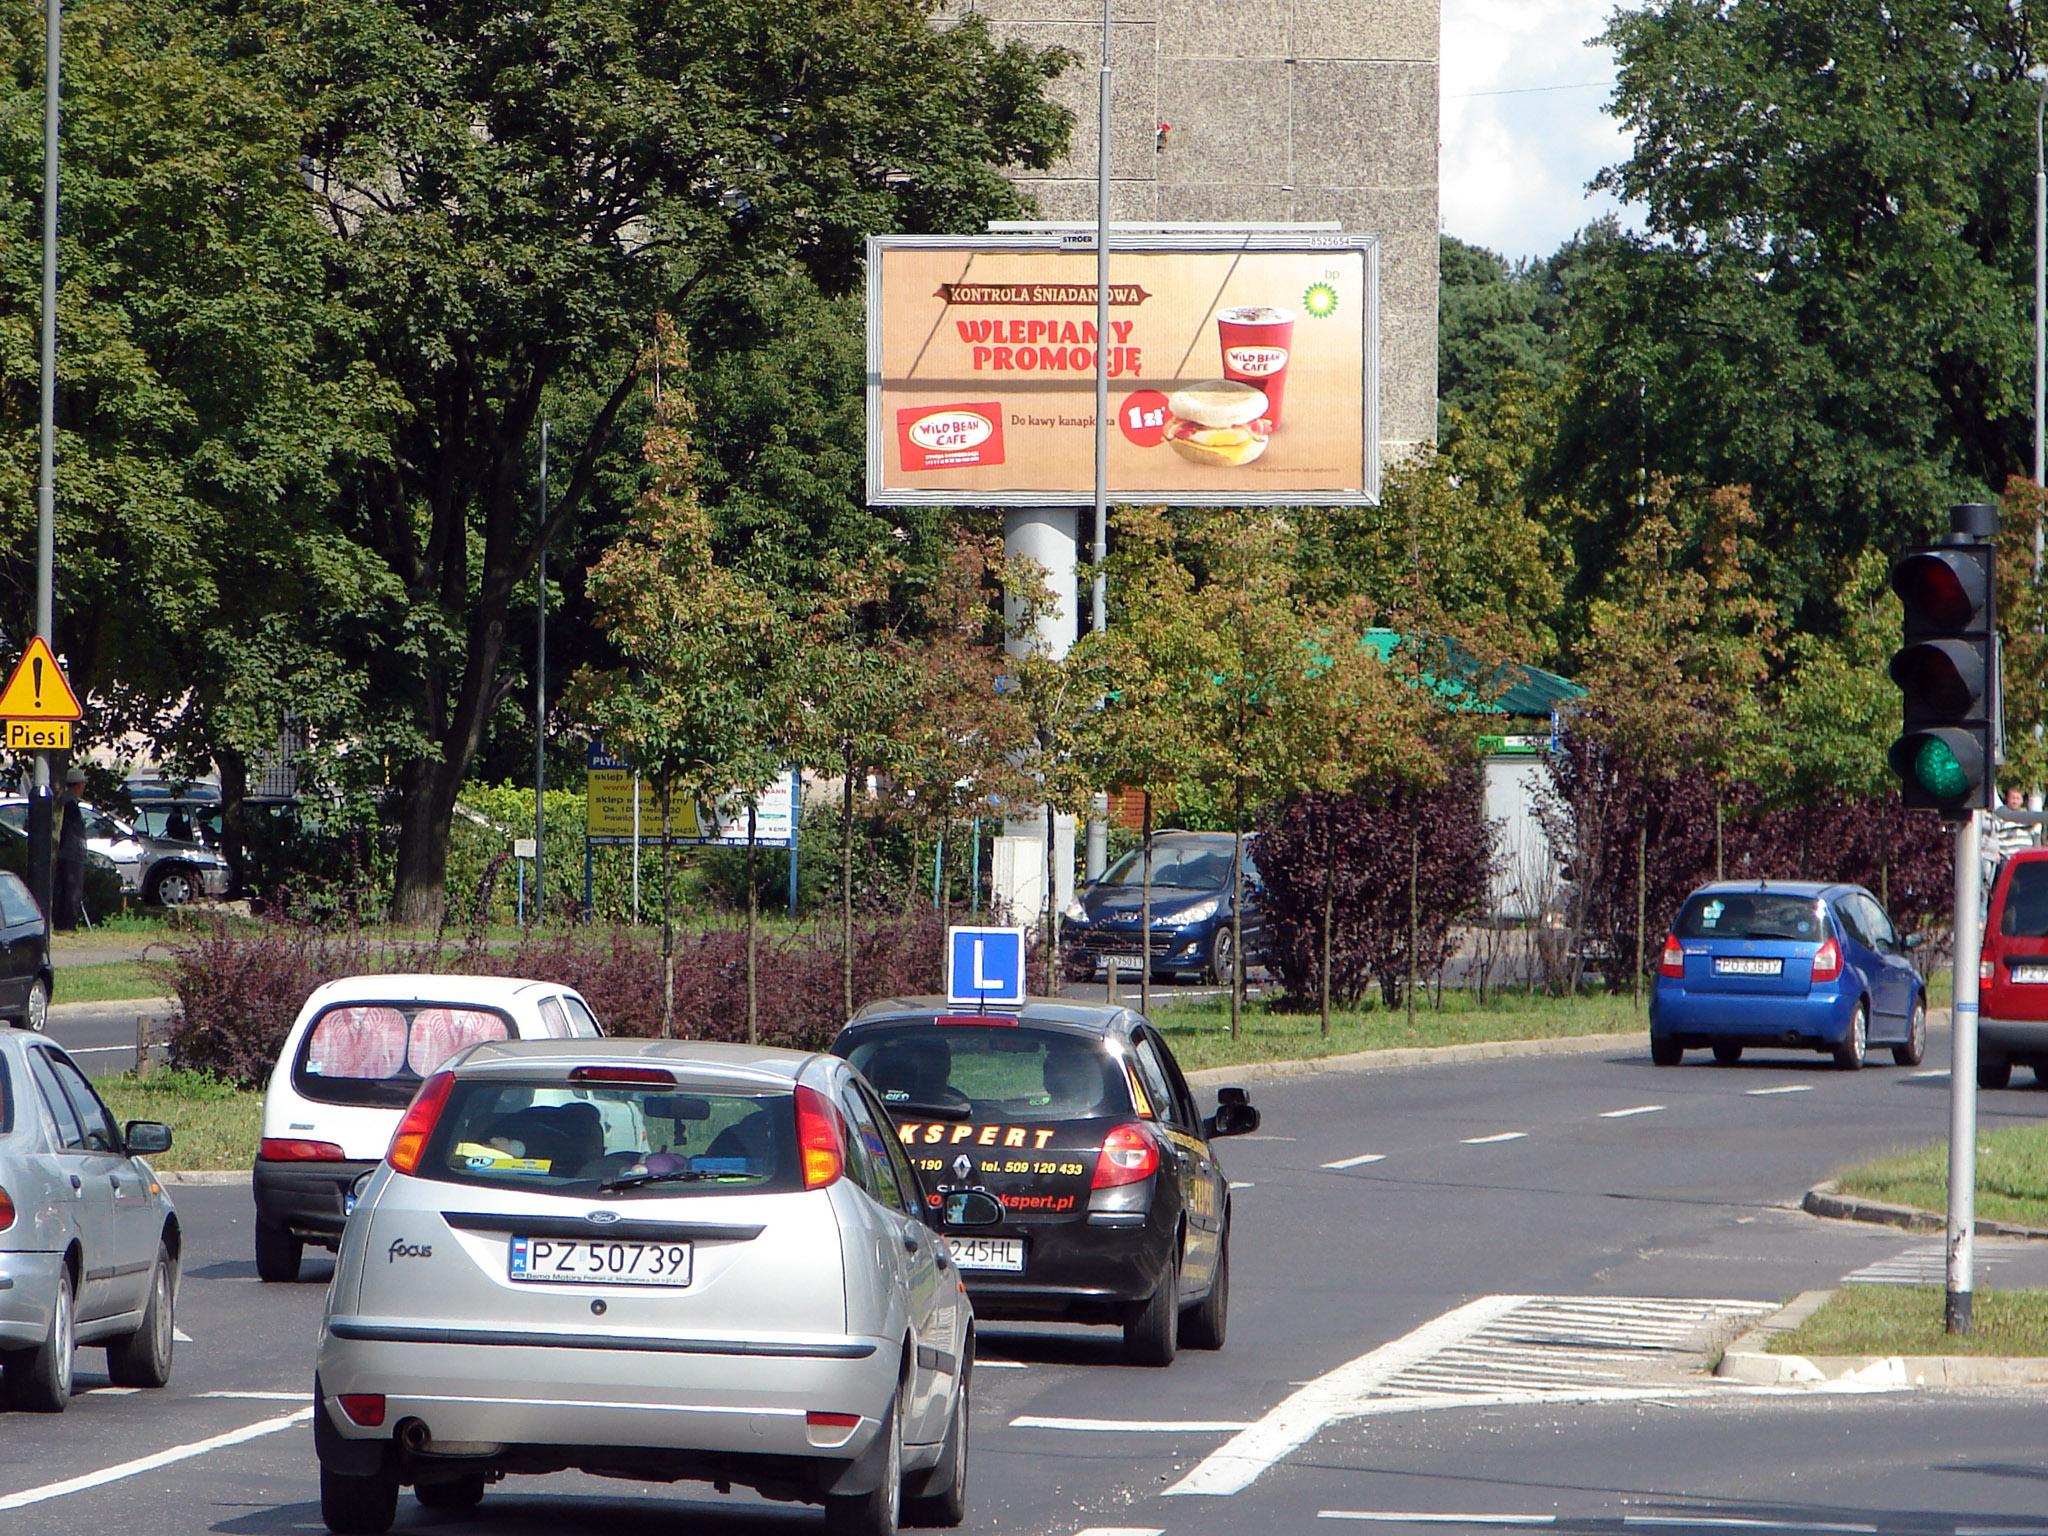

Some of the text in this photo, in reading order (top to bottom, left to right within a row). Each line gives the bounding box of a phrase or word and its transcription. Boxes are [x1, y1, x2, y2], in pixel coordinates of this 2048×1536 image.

[1325, 270, 1340, 281] bp
[951, 286, 1139, 303] KONTROLA ŚNIADANOWA
[953, 420, 979, 433] BEAN
[1011, 414, 1025, 426] Do
[1028, 414, 1057, 429] kawy
[1058, 414, 1097, 429] kanapk
[936, 434, 967, 446] CAFE
[11, 725, 64, 746] Piesi
[594, 772, 623, 782] sklep
[595, 796, 623, 805] sklep
[974, 940, 1004, 989] L
[898, 1122, 1055, 1149] KSPERT
[920, 1159, 943, 1171] 190
[981, 1160, 1000, 1173] tel.
[1004, 1161, 1029, 1173] 509
[1033, 1162, 1056, 1174] 120
[1059, 1163, 1083, 1176] 433
[998, 1194, 1075, 1211] kspert.pl
[388, 1237, 433, 1264] focus
[532, 1241, 685, 1275] PZ 50739
[514, 1259, 525, 1268] PL
